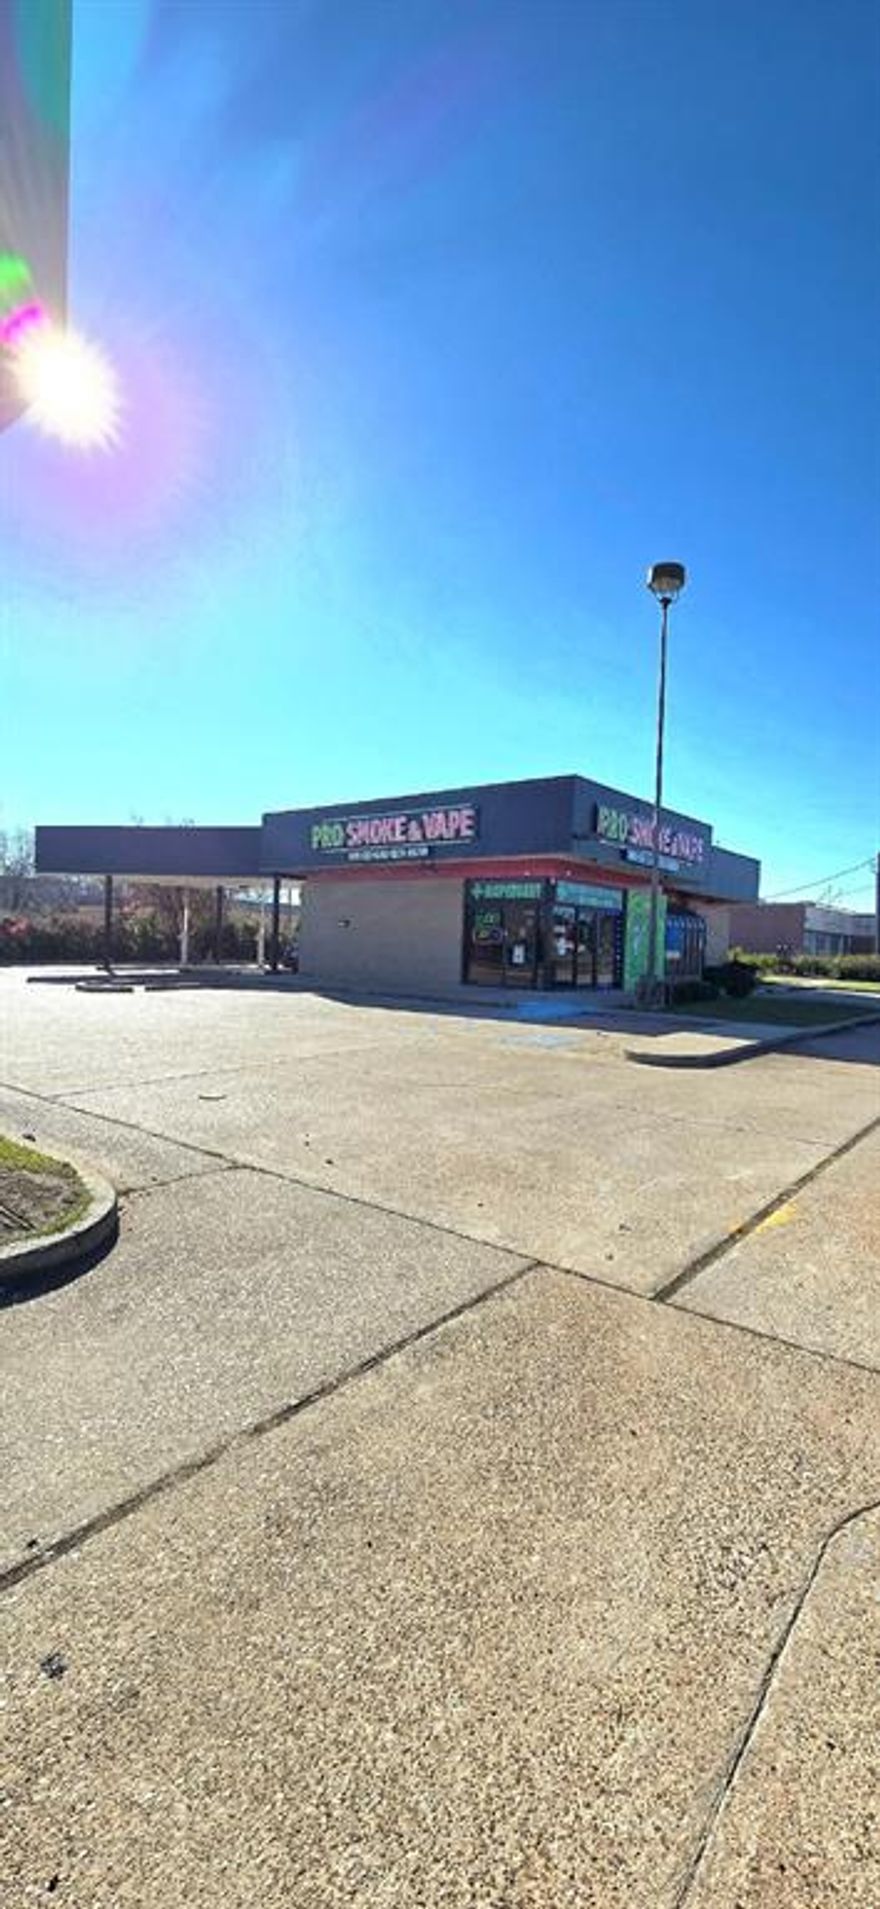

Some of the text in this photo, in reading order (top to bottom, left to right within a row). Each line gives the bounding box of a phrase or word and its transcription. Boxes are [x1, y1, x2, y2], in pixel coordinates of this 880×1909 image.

[311, 809, 475, 849] PRO SMOKE & VAPE
[597, 806, 627, 844] PRO
